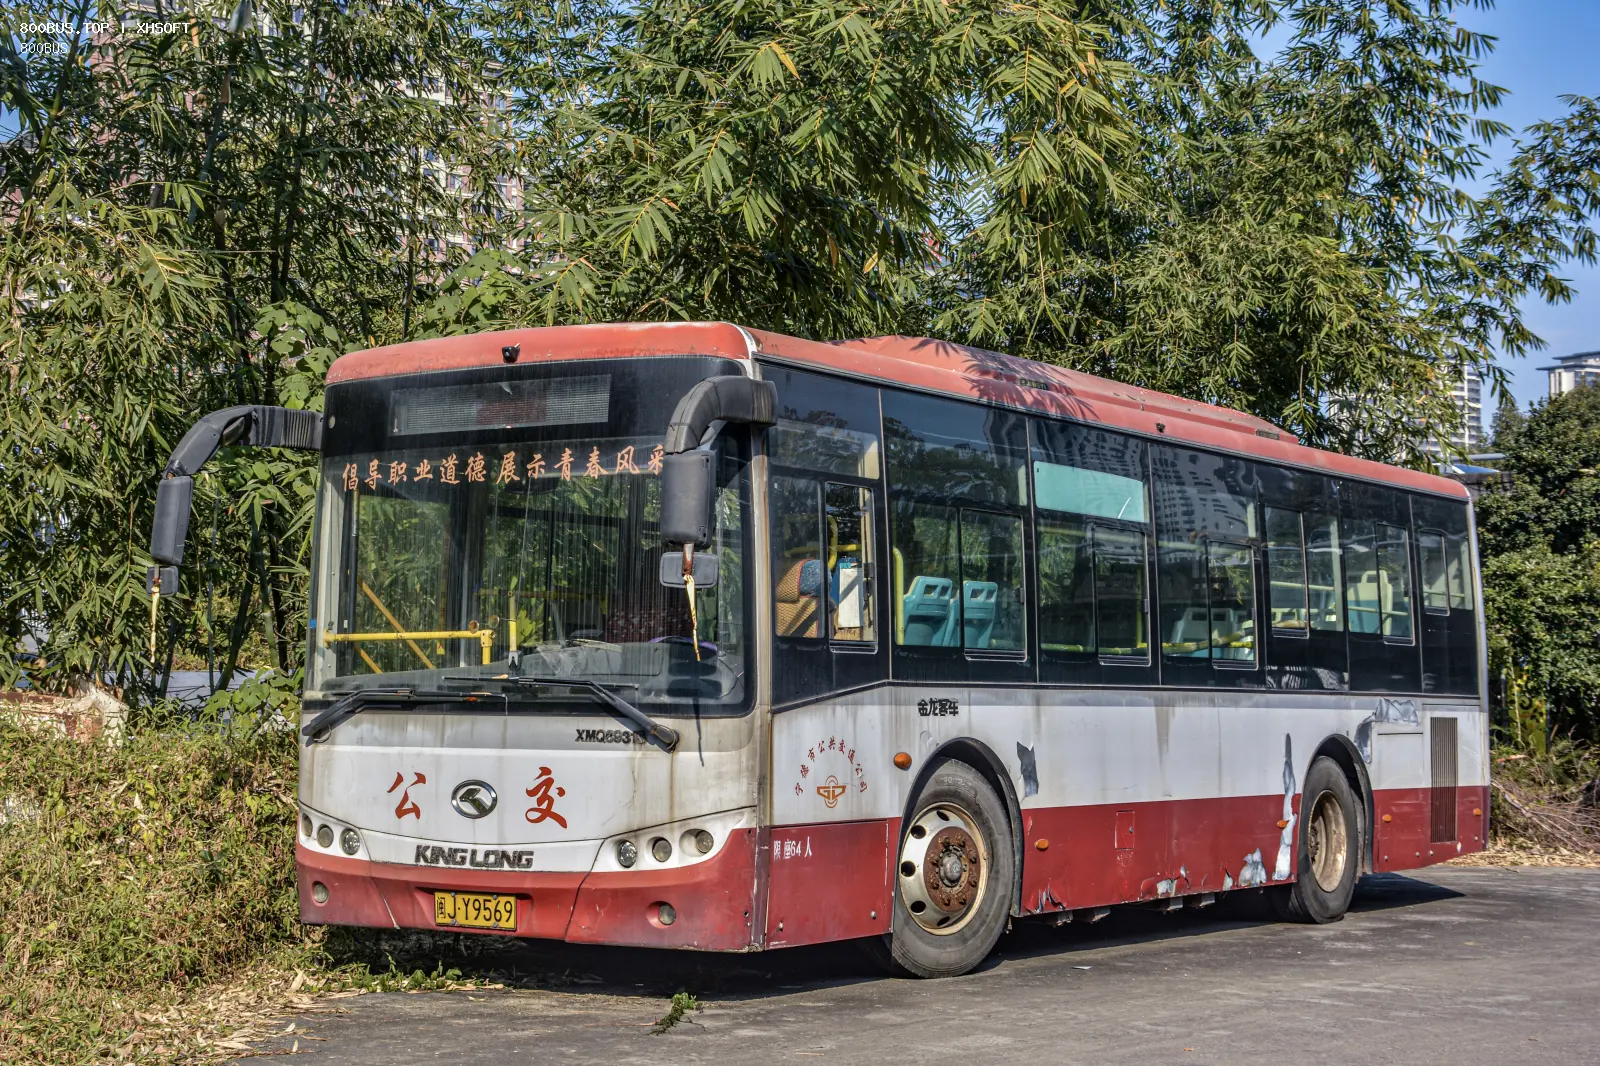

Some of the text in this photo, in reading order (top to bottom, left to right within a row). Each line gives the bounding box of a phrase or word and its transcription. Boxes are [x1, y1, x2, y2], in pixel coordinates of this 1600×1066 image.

[917, 697, 959, 717] 金龙客车
[387, 766, 568, 829] 公 交
[414, 844, 534, 869] KING LONG
